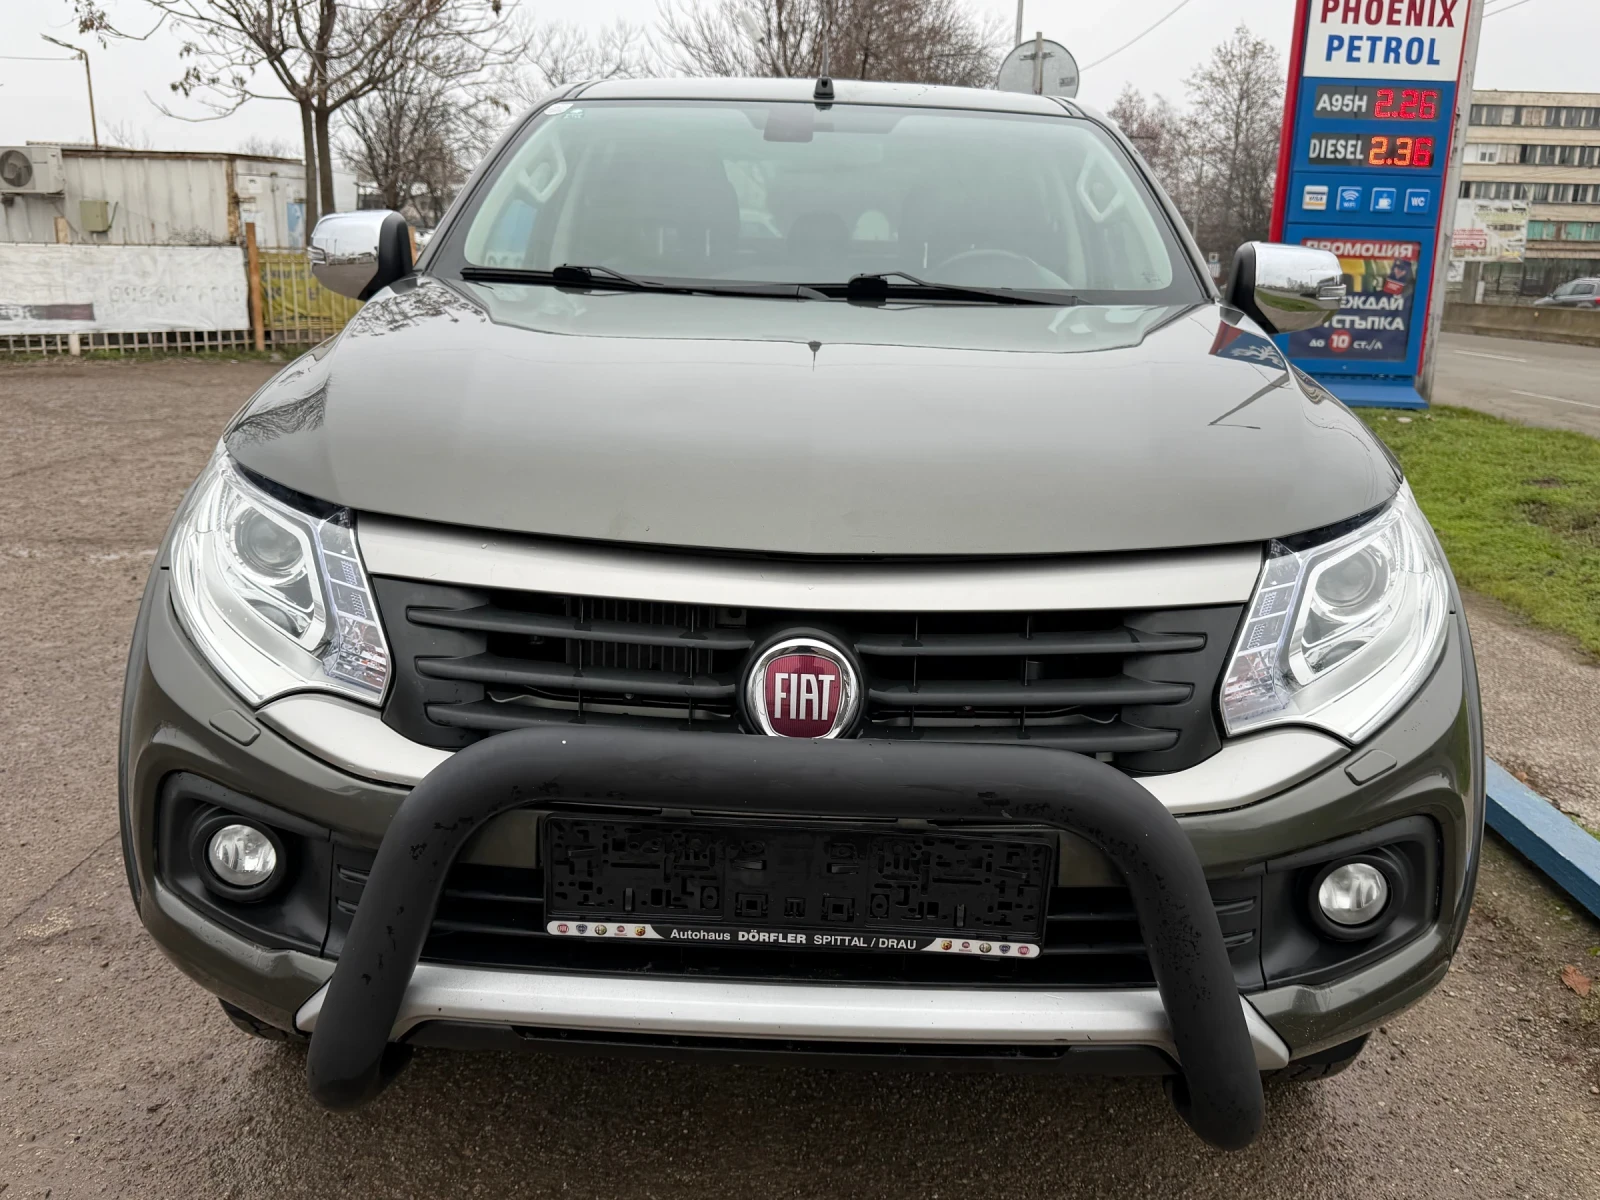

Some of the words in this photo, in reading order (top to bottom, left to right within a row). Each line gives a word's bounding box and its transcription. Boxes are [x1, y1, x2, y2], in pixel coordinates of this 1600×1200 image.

[1320, 0, 1458, 28] PHOENIX
[1325, 34, 1441, 66] PETROL
[1374, 88, 1438, 119] 2.26
[1308, 138, 1364, 160] DIESEL
[1368, 136, 1434, 167] 2.36
[1410, 196, 1426, 207] WC
[1340, 295, 1405, 311] ЕЖДАЙ
[1323, 314, 1405, 331] СТЪПКА
[1331, 334, 1350, 349] 10
[774, 672, 836, 721] FIAT
[670, 928, 731, 941] Autohaus
[738, 929, 807, 944] DÖRFLER
[813, 934, 868, 947] SPITTAL
[878, 938, 917, 950] DRAU
